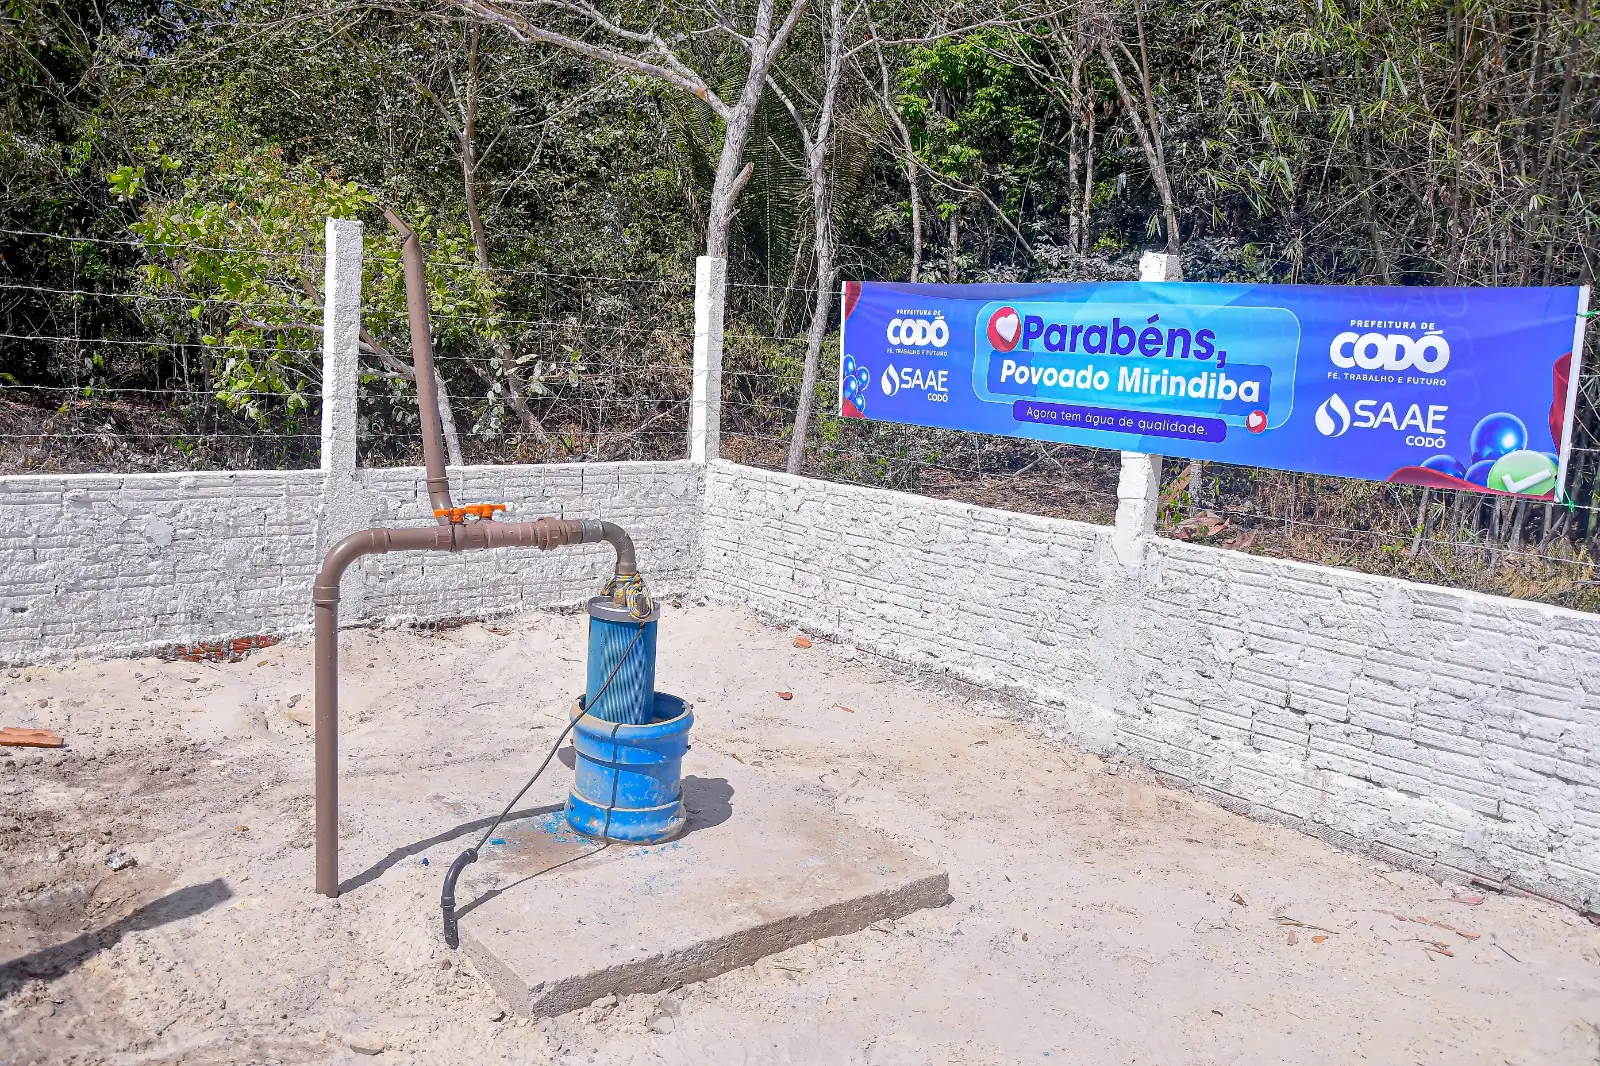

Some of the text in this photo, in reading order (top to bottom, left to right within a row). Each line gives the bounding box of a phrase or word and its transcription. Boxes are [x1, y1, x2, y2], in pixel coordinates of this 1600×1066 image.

[886, 315, 950, 348] CODÓ
[1350, 319, 1436, 330] PREFEITURA DE
[1021, 313, 1227, 369] Parabéns,
[1329, 329, 1450, 374] CODÓ
[900, 367, 949, 392] SAAE
[1000, 359, 1260, 403] Povoado Mirindiba
[1343, 372, 1395, 383] TRABALHO
[1397, 376, 1404, 384] E
[1406, 376, 1447, 387] FUTURO
[927, 392, 949, 403] CODÓ
[1026, 406, 1209, 436] Agora tem água de qualidade.
[1352, 399, 1449, 435] SAAE
[1405, 435, 1446, 449] CODÓ
